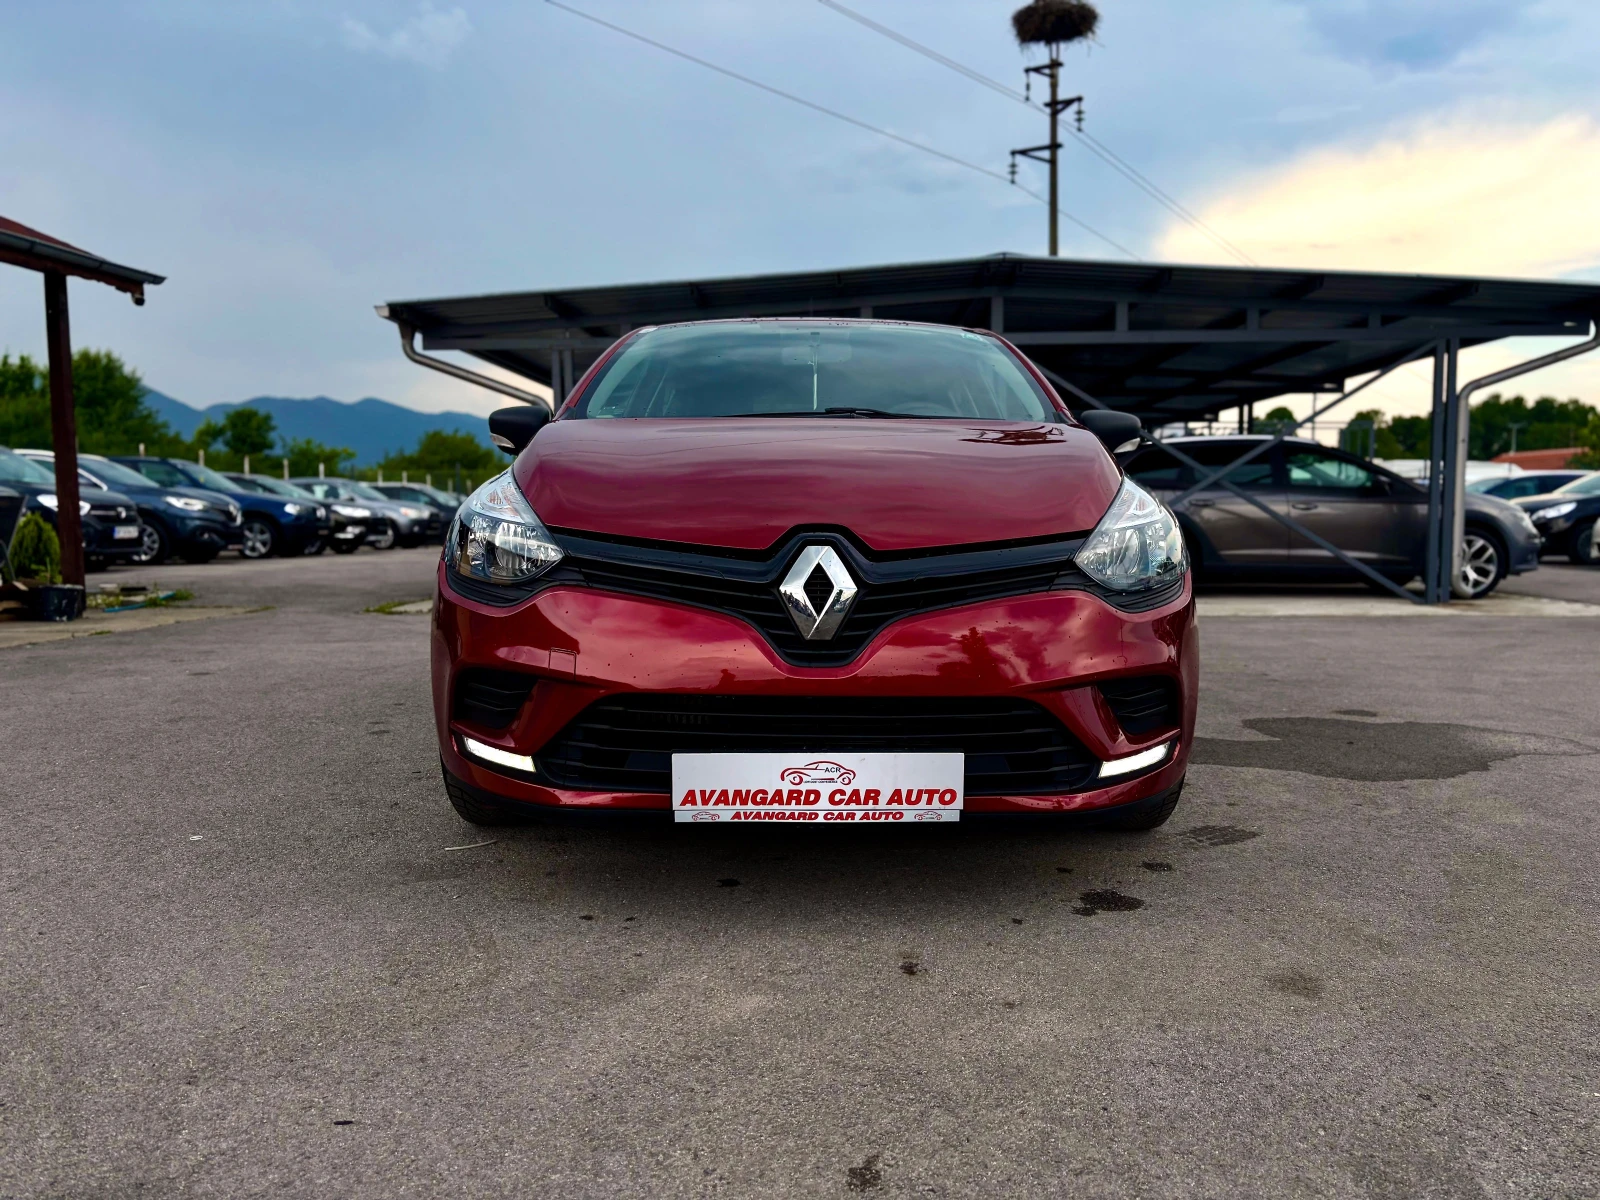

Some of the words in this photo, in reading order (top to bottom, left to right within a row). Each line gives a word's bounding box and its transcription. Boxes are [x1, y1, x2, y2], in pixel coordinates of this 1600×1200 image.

[680, 789, 821, 806] AVANGARD
[828, 788, 881, 806] CAR
[886, 788, 957, 806] AUTO
[730, 811, 819, 821] AVANGARD
[823, 811, 856, 821] CAR
[859, 811, 904, 821] AUTO
